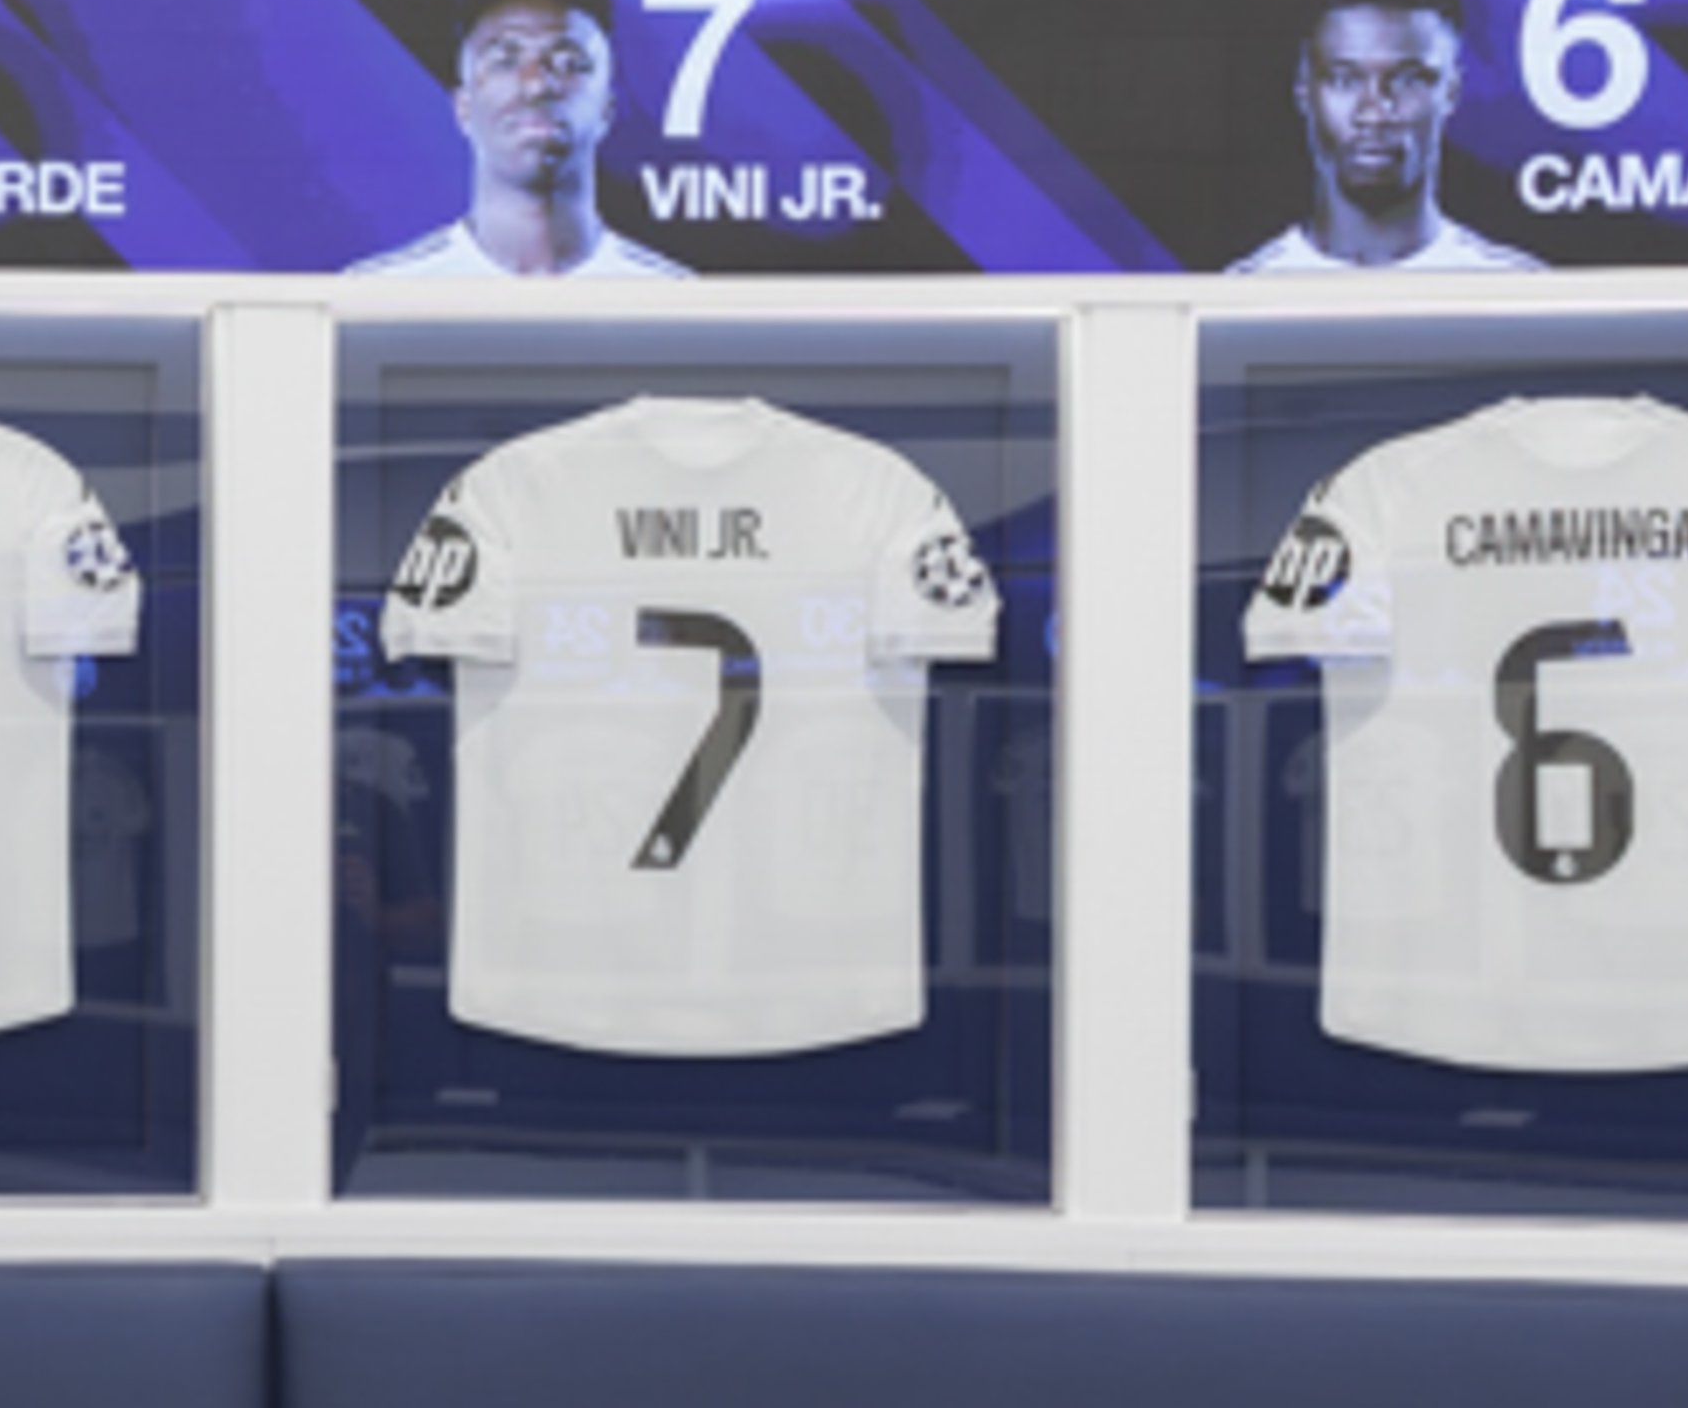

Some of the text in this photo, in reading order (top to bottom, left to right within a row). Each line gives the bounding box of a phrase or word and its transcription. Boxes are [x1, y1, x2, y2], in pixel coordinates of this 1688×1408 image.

[640, 164, 884, 221] VINI JR.
[615, 506, 770, 562] VINI JR.
[630, 606, 762, 870] 7
[1493, 617, 1635, 885] 6
